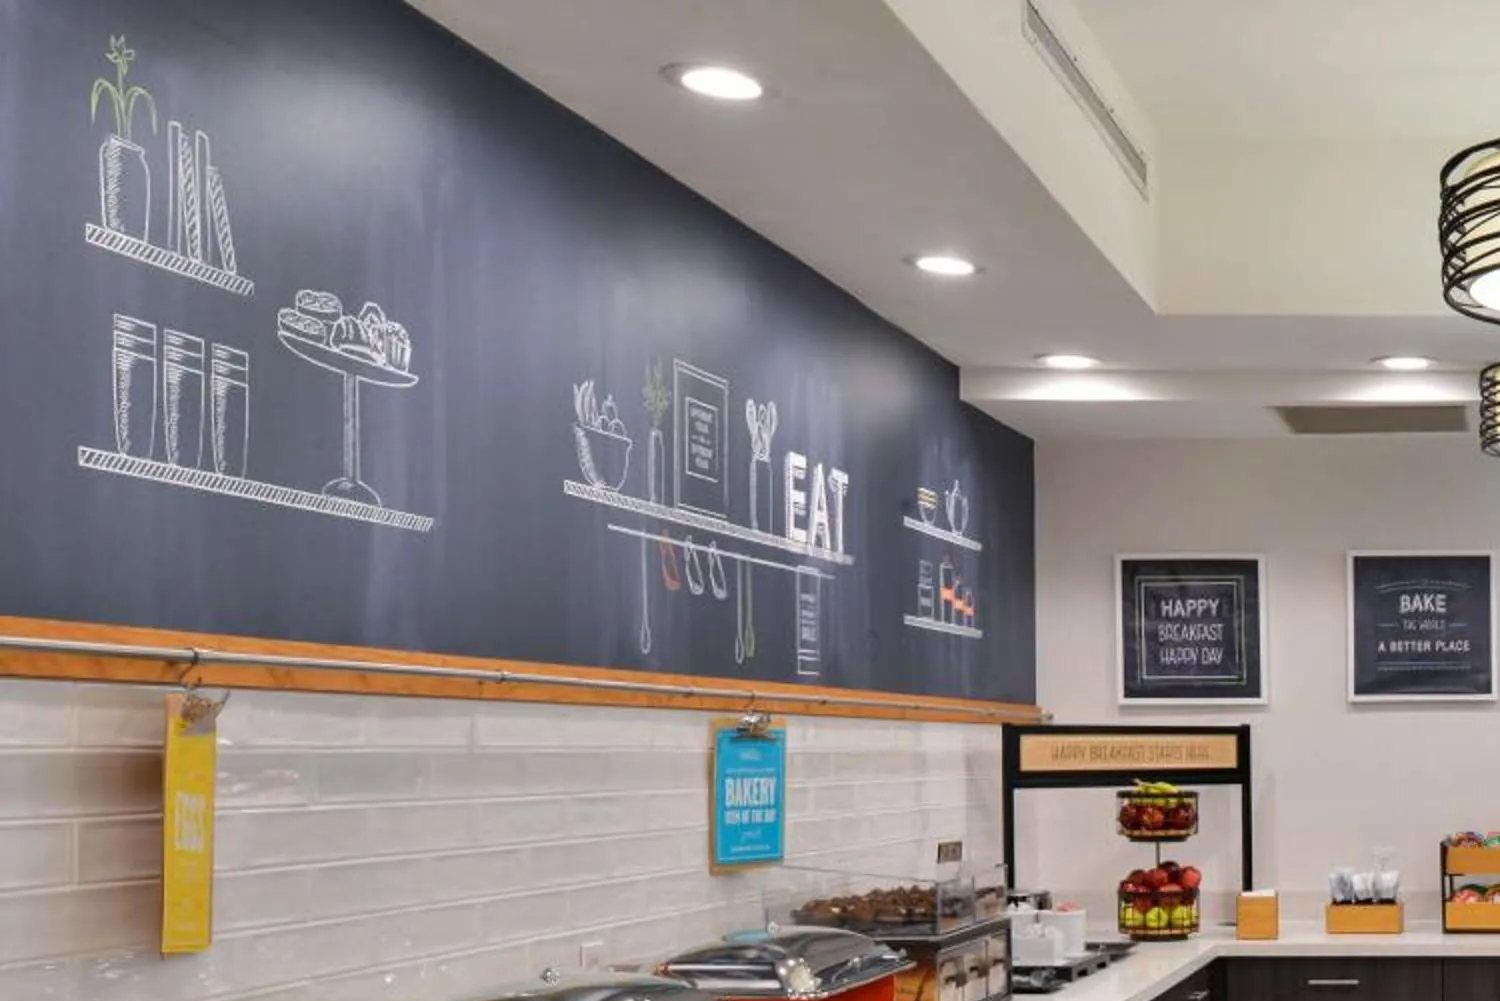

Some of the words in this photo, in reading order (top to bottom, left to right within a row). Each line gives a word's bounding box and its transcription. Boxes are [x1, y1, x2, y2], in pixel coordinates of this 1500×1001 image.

[785, 451, 848, 554] EAT
[1160, 598, 1220, 618] HAPPY
[1399, 594, 1447, 613] BAKE
[1158, 623, 1224, 642] BREAKFAST
[1159, 647, 1199, 665] HAPPY
[1201, 647, 1224, 665] DAY
[1377, 640, 1386, 653] A
[1389, 640, 1432, 653] BETTER
[1435, 640, 1471, 653] PLACE
[725, 777, 776, 807] BAKERY
